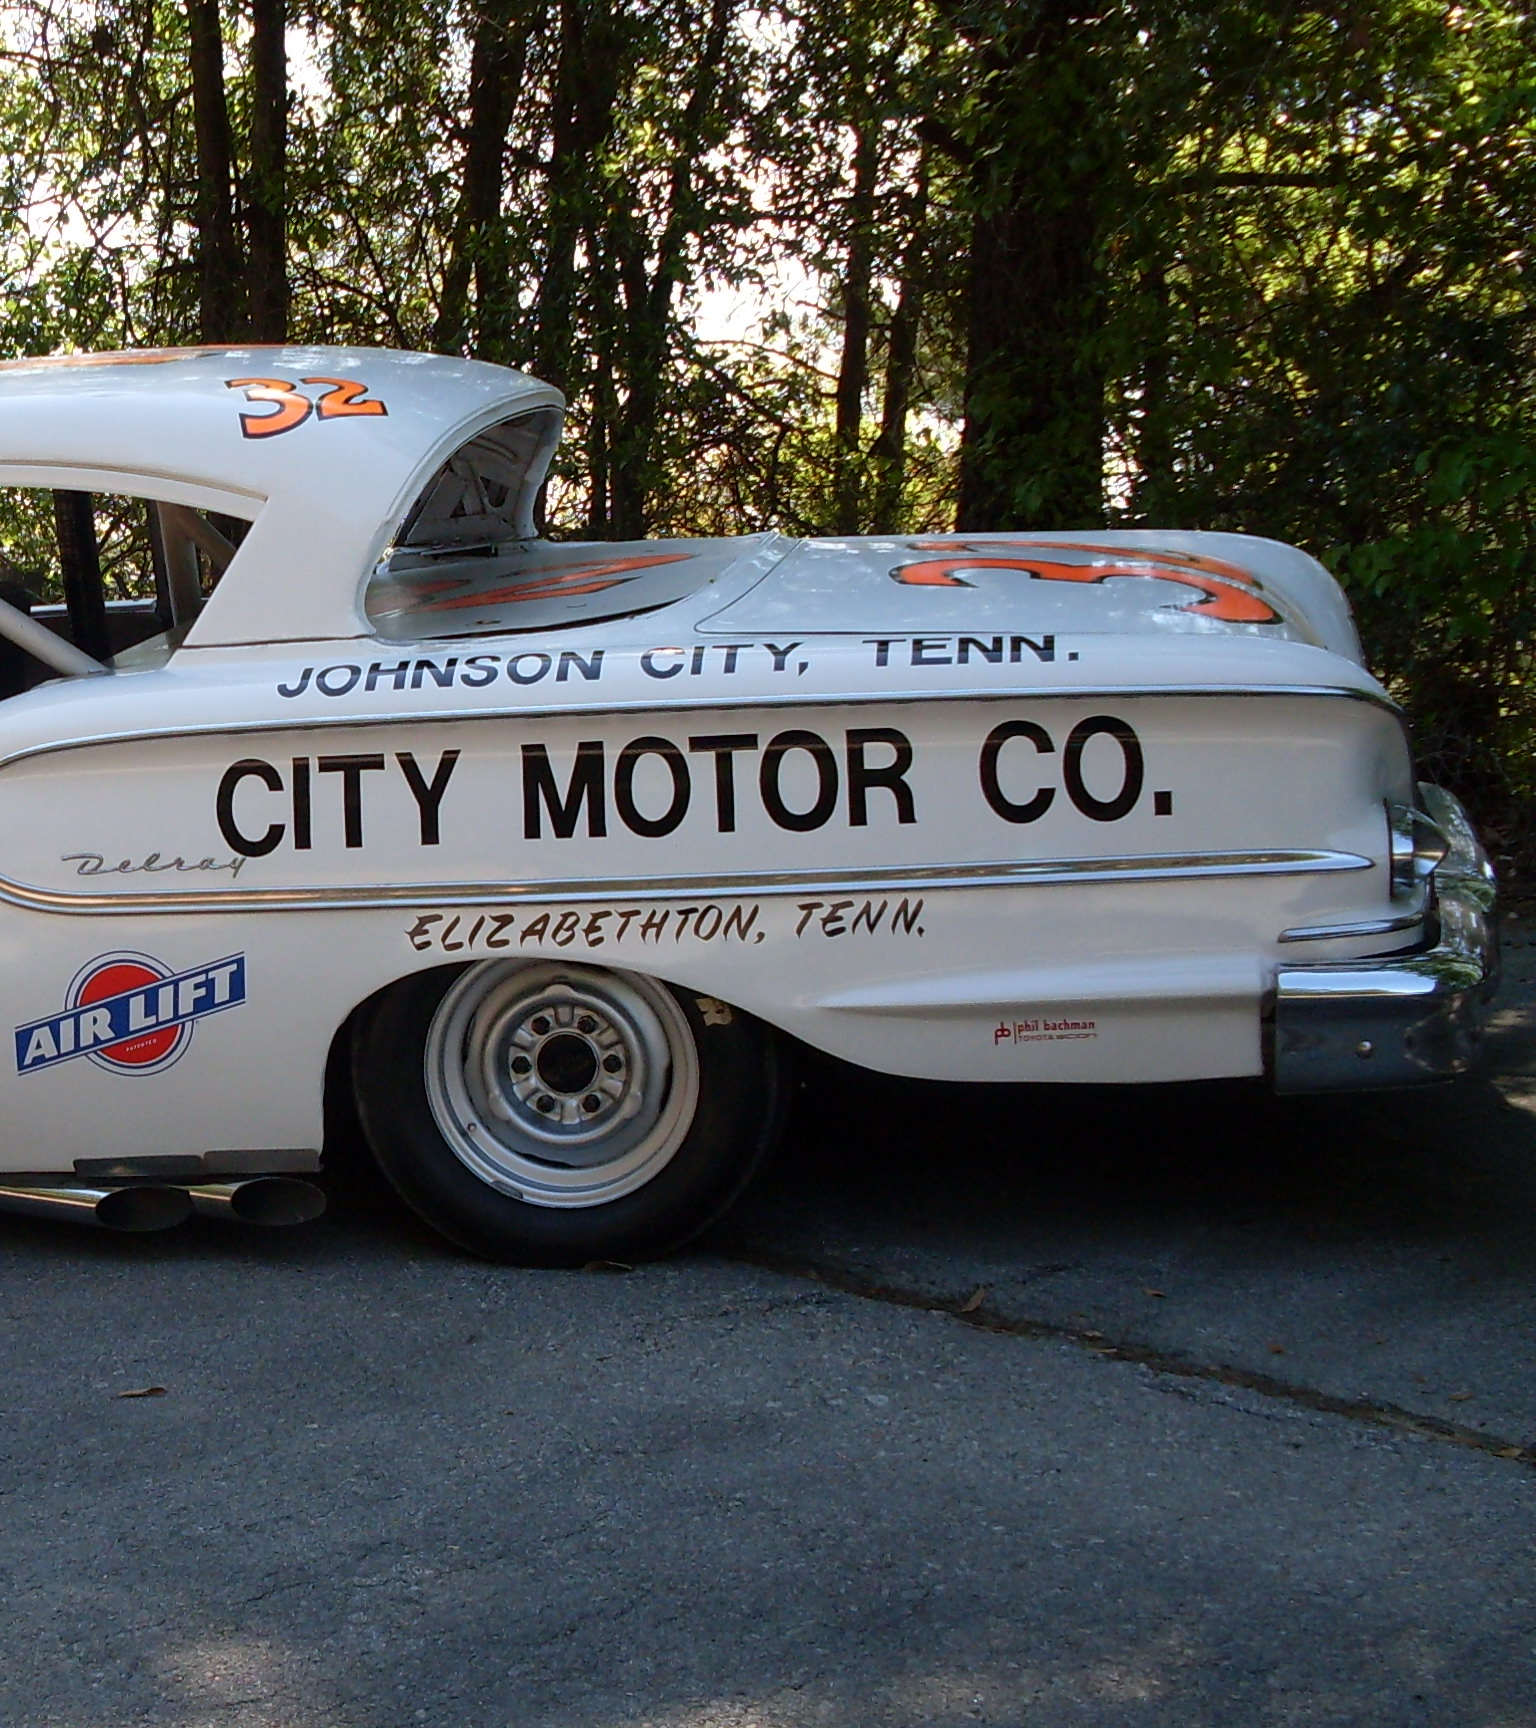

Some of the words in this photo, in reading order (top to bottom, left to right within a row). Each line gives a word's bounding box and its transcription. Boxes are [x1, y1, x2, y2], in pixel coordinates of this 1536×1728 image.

[224, 376, 389, 439] 32
[276, 649, 605, 698] JOHNSON
[640, 641, 809, 679] CITY,
[862, 634, 1079, 668] TENN.
[216, 749, 462, 858] CITY
[520, 727, 917, 840] MOTOR
[979, 714, 1173, 824] CO.
[61, 852, 247, 879] Delray
[403, 904, 766, 951] ELIZABETHTON,
[794, 898, 927, 938] TENN.
[22, 1007, 116, 1066] AIR
[129, 963, 238, 1032] LIFT
[1017, 1019, 1039, 1034] phil
[1043, 1018, 1095, 1031] bachman
